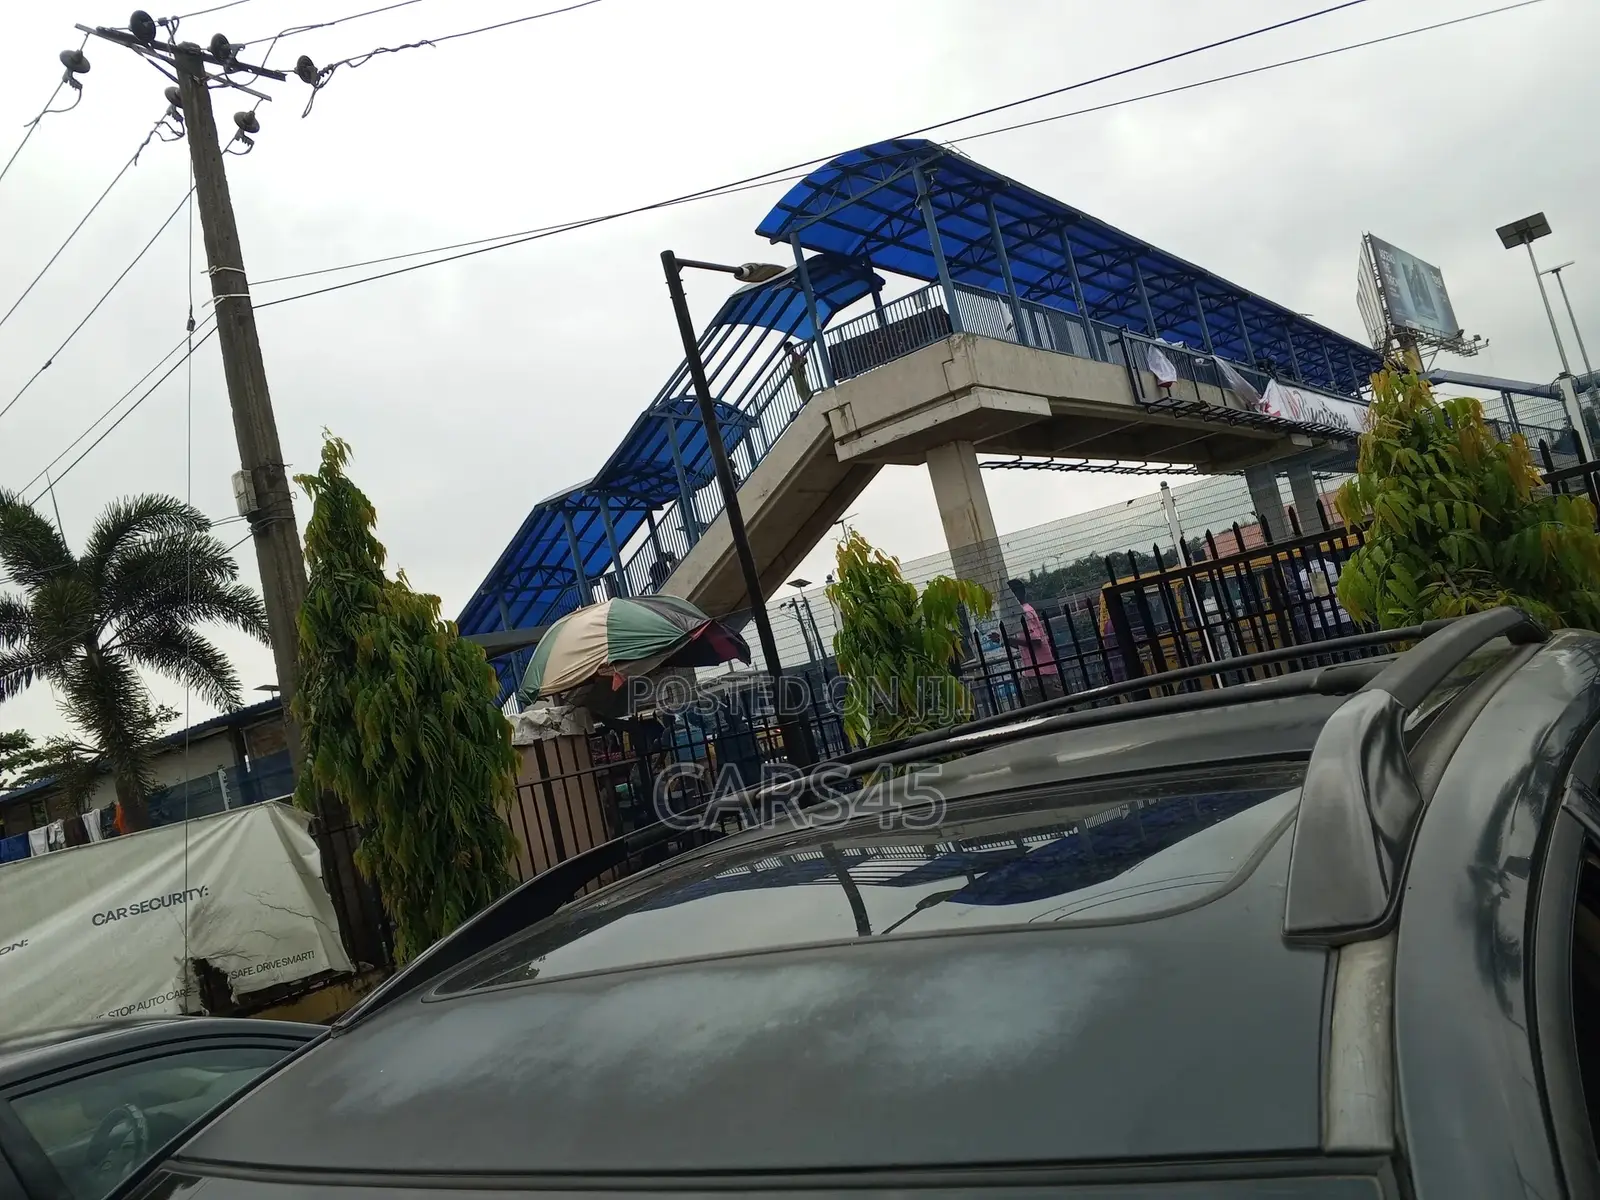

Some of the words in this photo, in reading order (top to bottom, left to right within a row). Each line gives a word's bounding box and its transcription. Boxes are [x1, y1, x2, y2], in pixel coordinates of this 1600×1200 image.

[92, 907, 128, 926] CAR
[129, 885, 209, 916] SECURITY:
[230, 966, 256, 979] SAFE.
[256, 960, 281, 973] DRIVE
[281, 950, 315, 967] SMART!
[108, 1004, 136, 1018] STOP
[136, 994, 165, 1012] AUTO
[166, 986, 192, 1001] CARE
